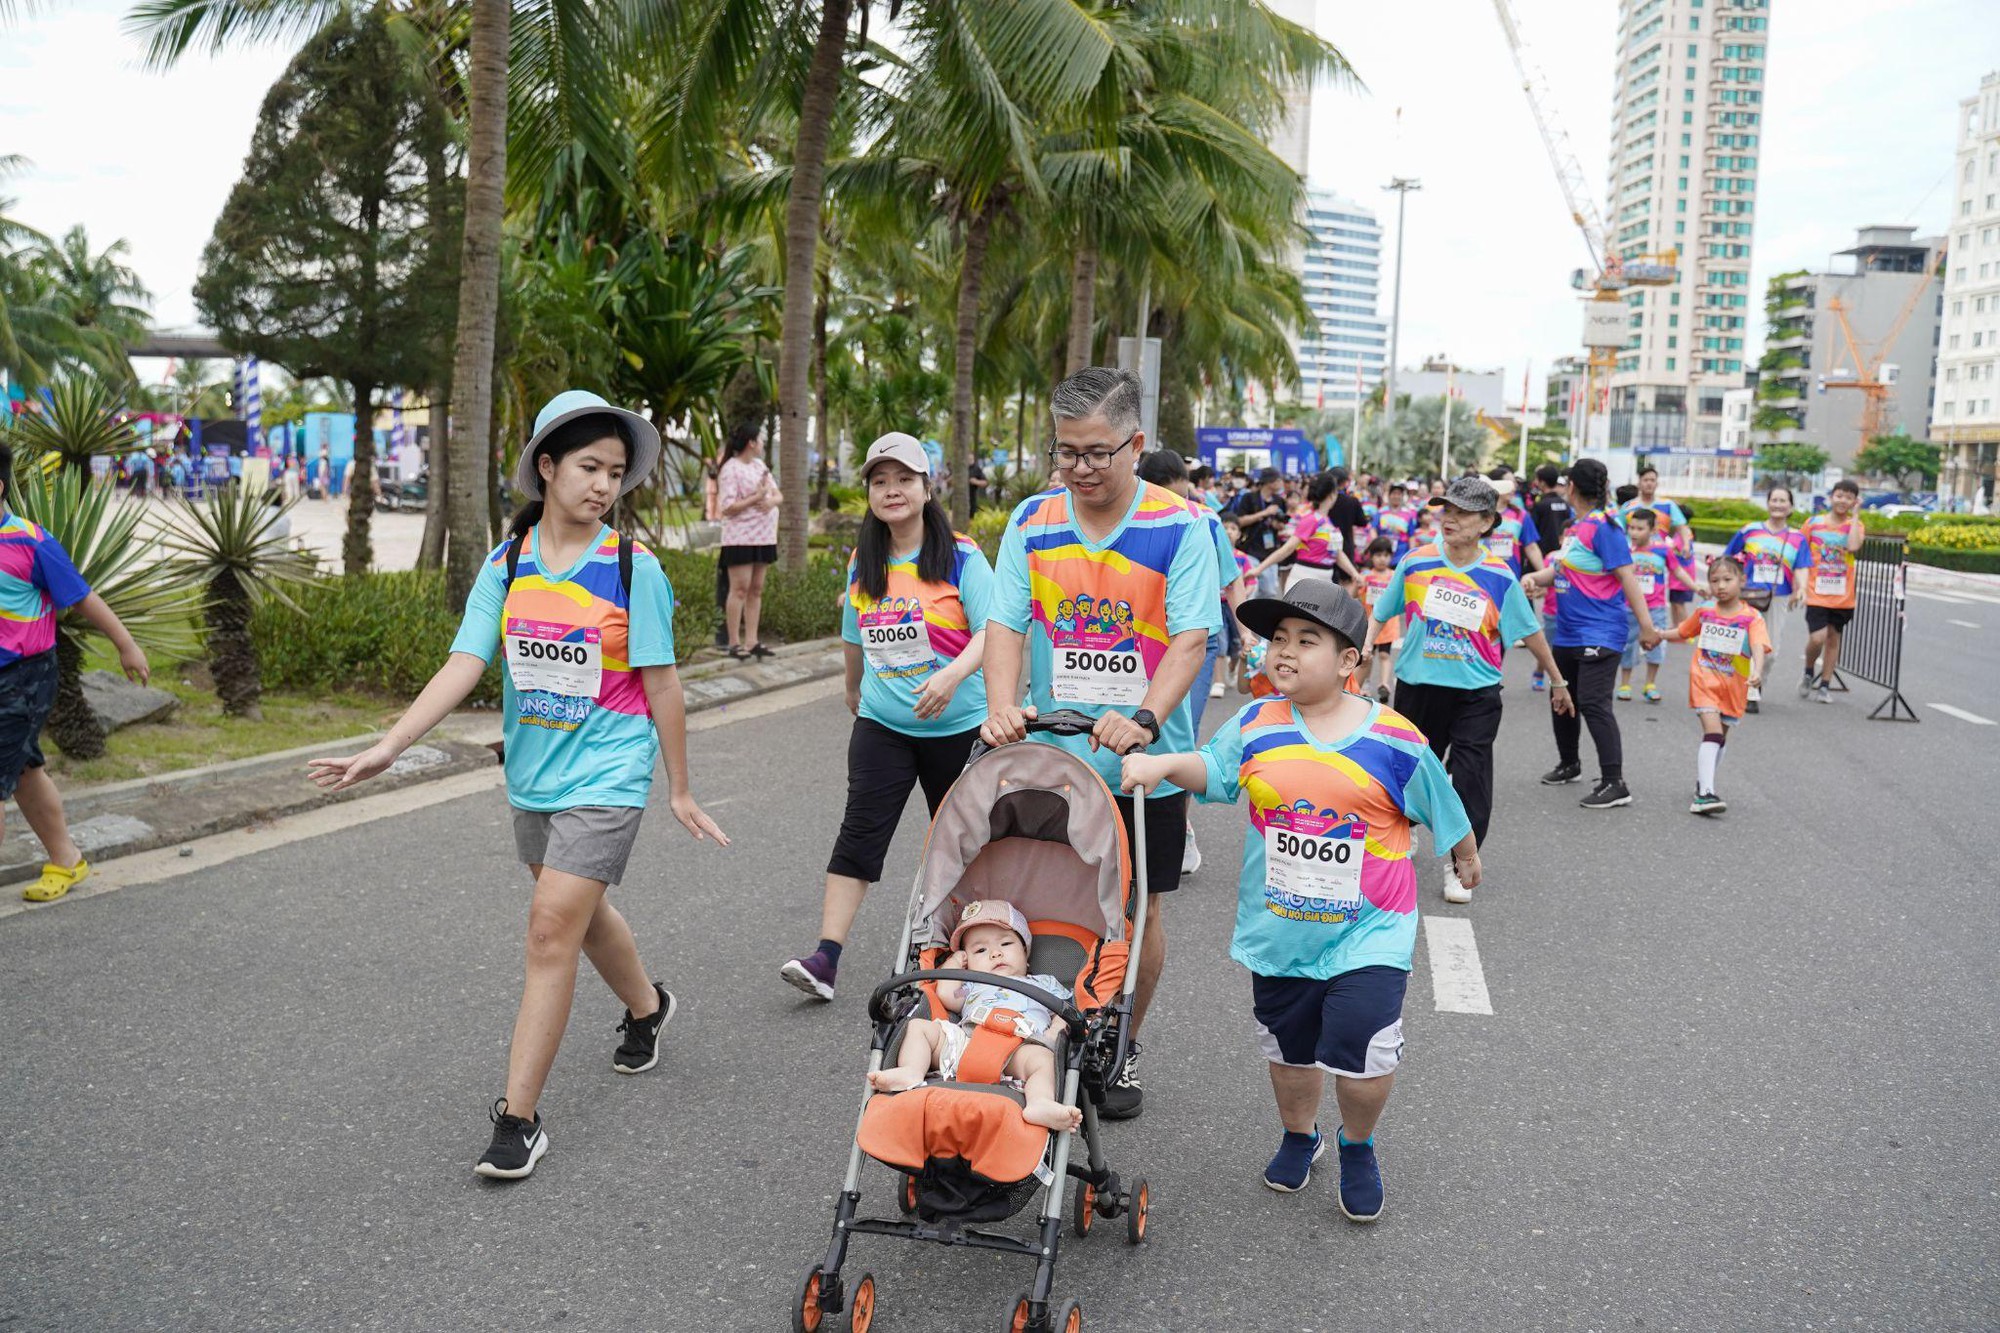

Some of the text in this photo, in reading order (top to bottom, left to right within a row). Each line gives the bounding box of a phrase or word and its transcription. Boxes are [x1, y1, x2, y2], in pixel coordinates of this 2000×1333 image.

[1434, 589, 1477, 610] 50056
[868, 626, 918, 643] 50060
[1704, 625, 1738, 639] 50022
[518, 640, 588, 665] 50060
[1064, 651, 1137, 673] 50060
[1276, 832, 1351, 864] 50060
